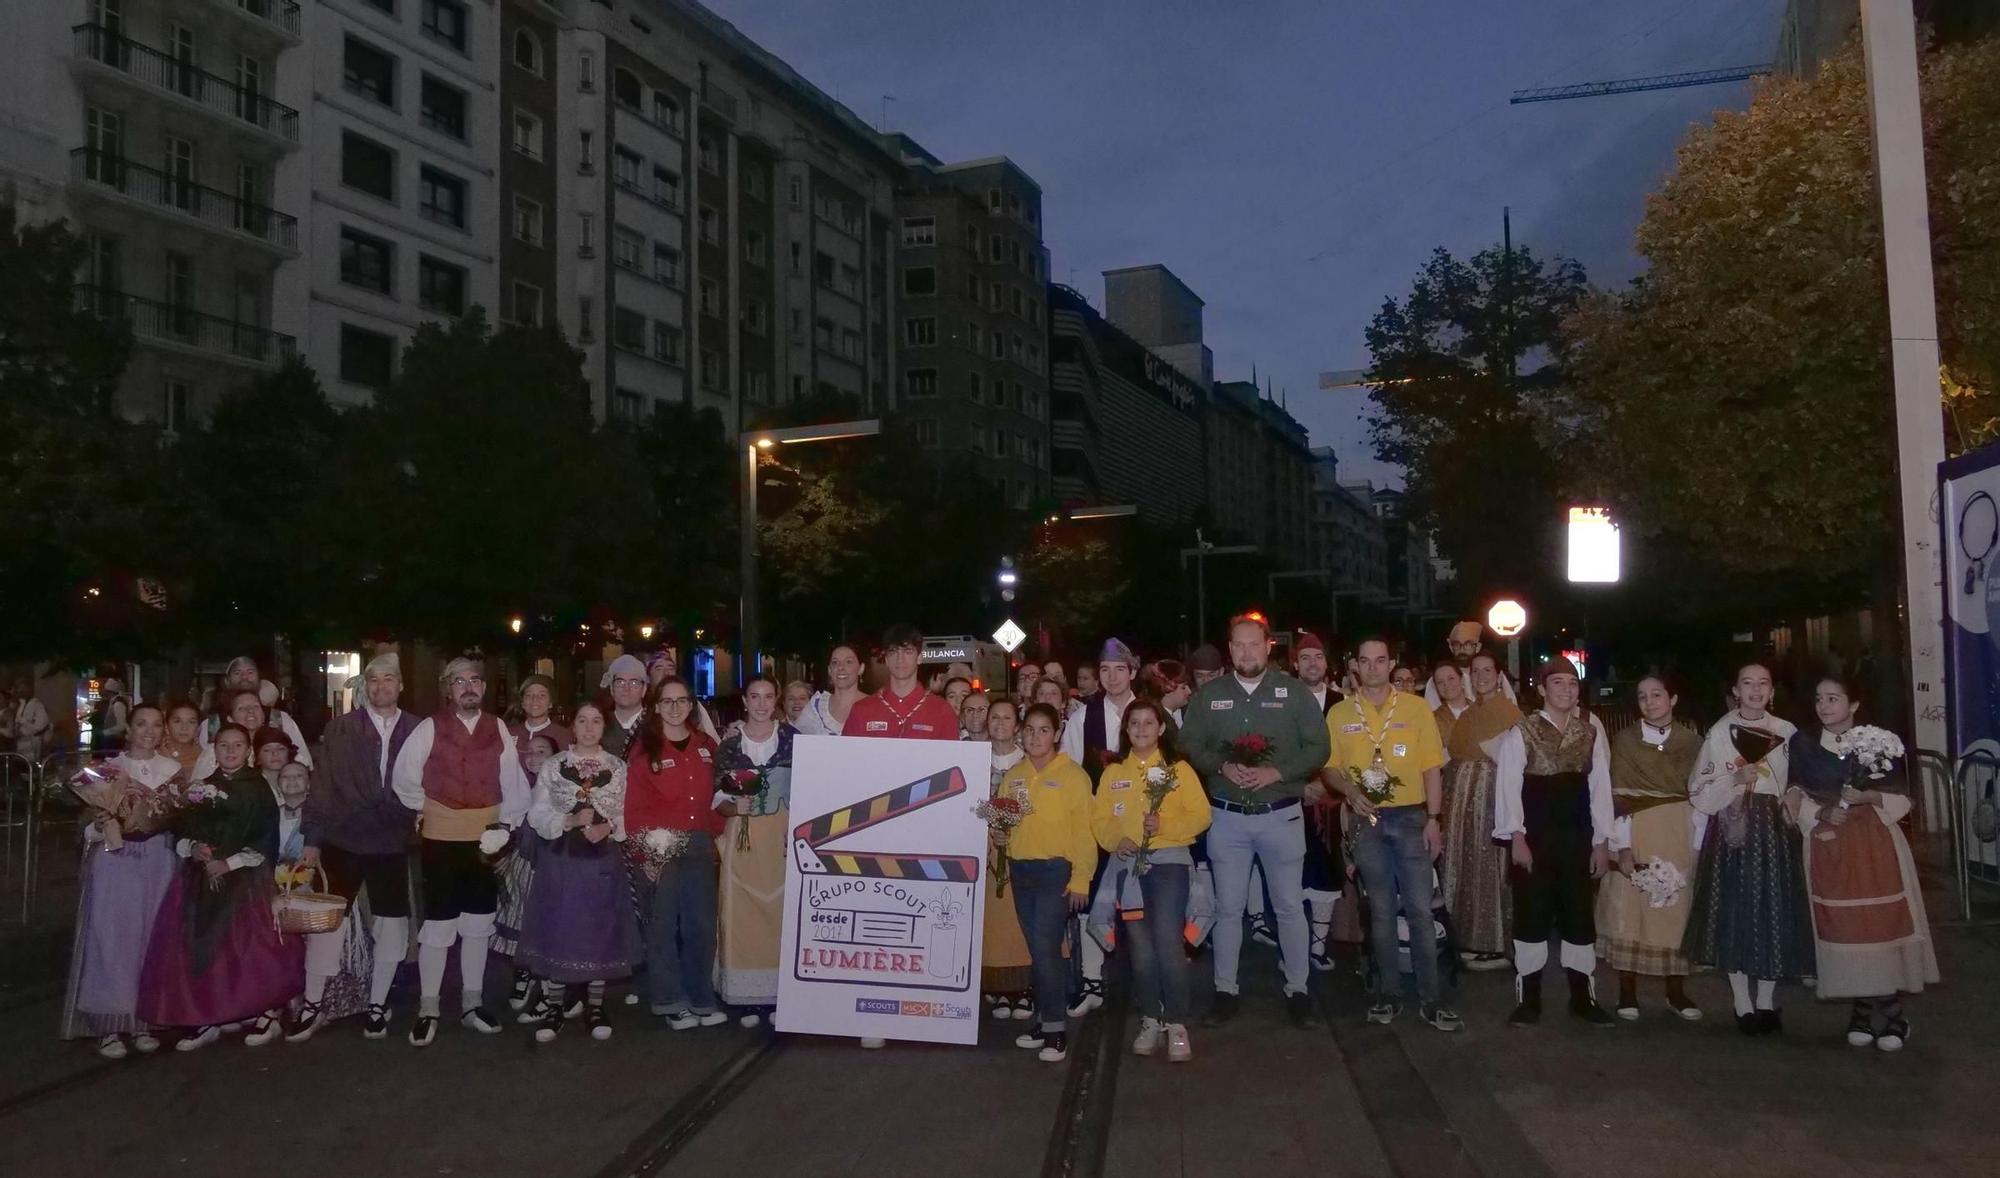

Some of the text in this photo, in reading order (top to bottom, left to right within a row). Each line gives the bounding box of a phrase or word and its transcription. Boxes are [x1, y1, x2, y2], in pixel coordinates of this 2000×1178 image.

[921, 649, 966, 659] BULANCIA
[809, 880, 927, 913] GRUPO SCOUT
[811, 911, 848, 924] desde
[801, 947, 925, 973] LUMIÈRE
[867, 1001, 896, 1011] SCOUTS
